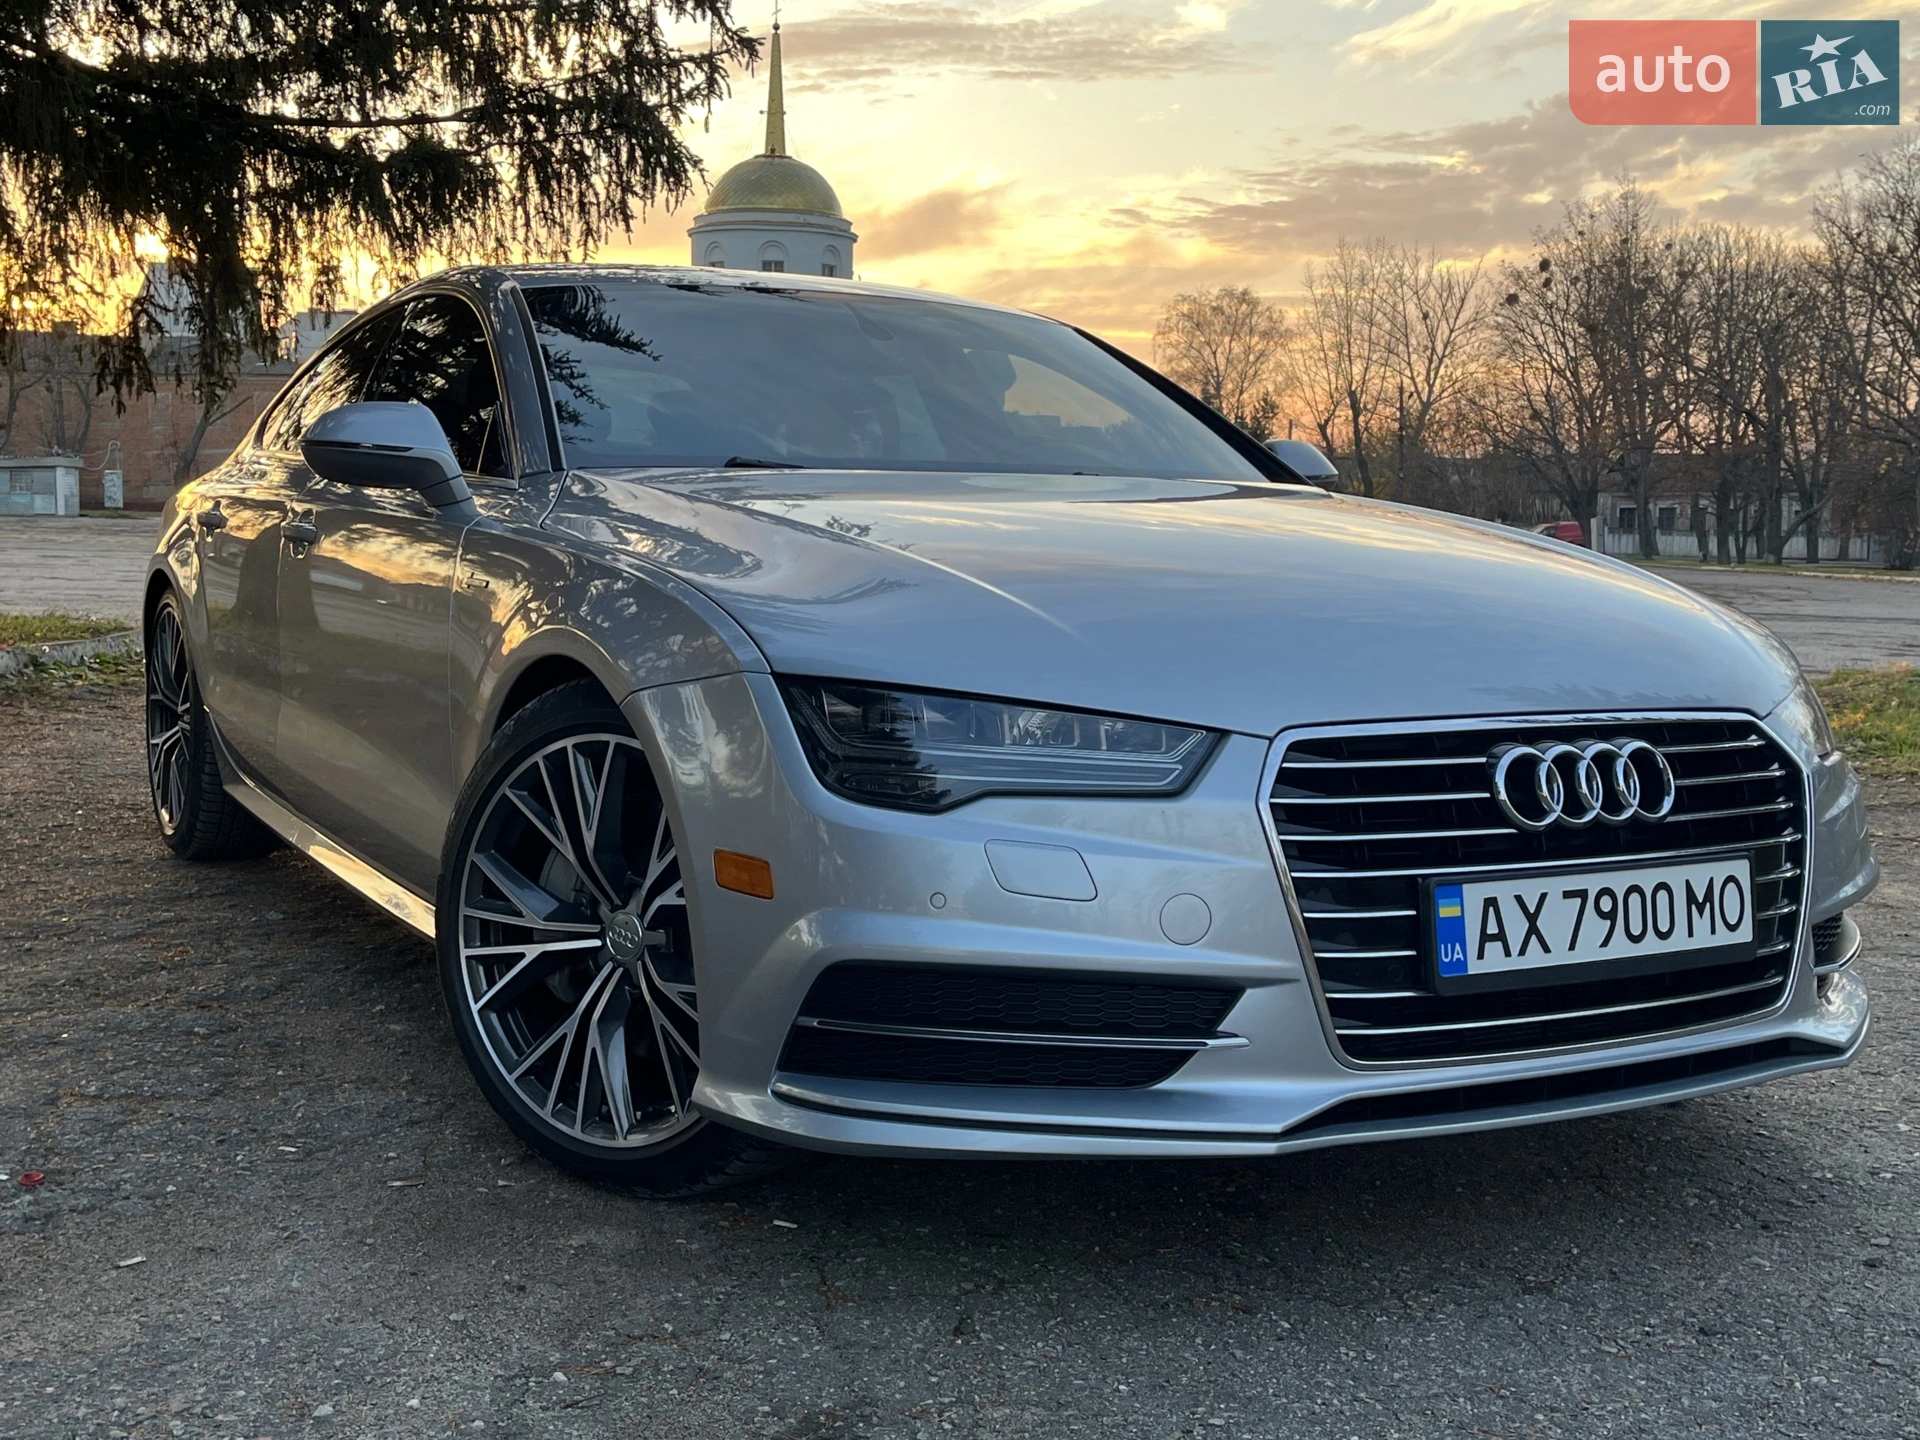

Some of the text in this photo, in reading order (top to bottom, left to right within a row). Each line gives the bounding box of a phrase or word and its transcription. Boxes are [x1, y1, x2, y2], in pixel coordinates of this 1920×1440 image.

[1476, 874, 1746, 961] AX 7900 MO
[1440, 943, 1465, 963] UA
